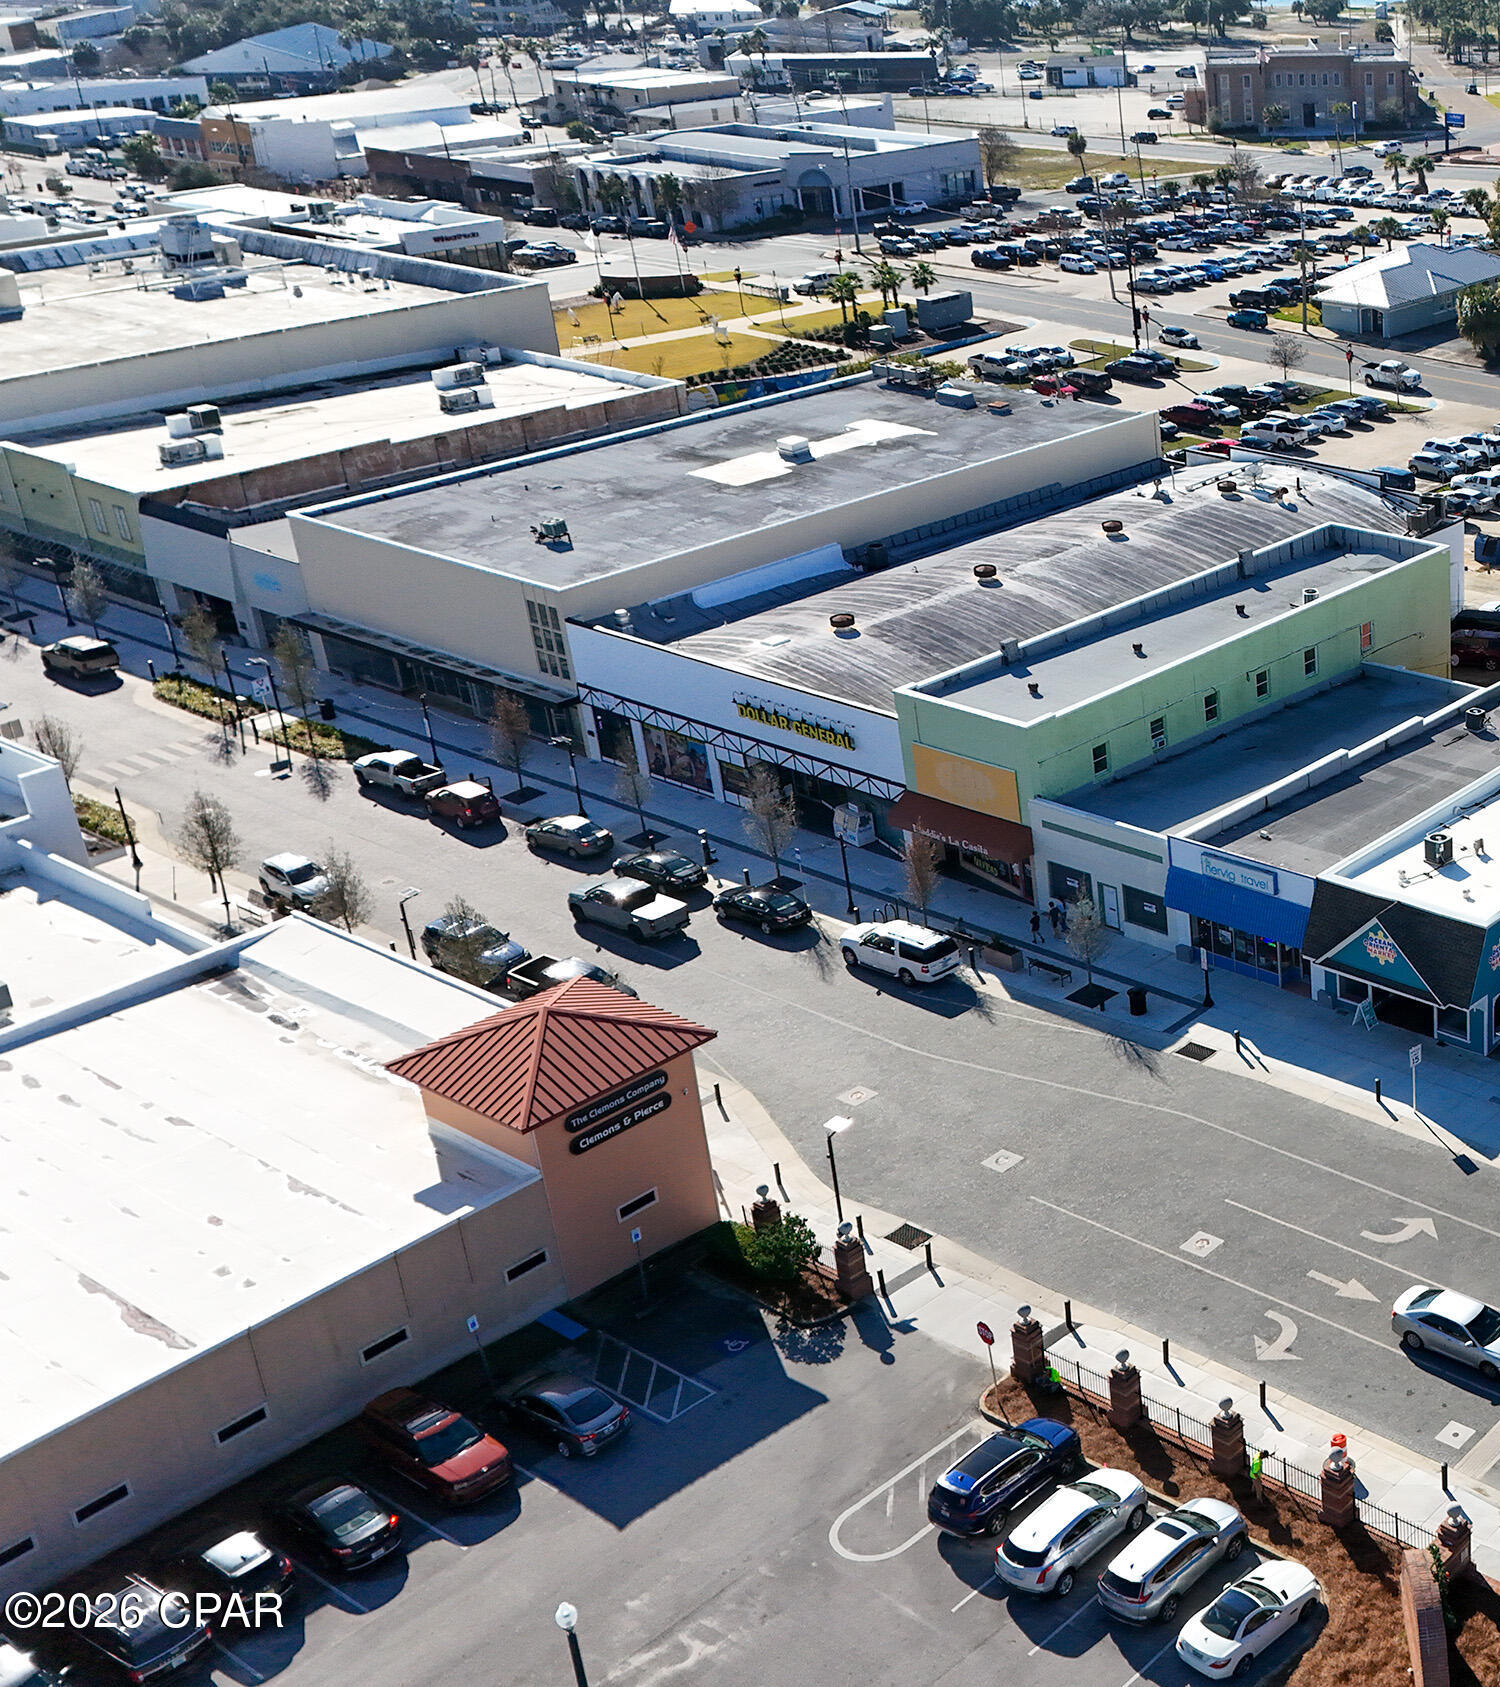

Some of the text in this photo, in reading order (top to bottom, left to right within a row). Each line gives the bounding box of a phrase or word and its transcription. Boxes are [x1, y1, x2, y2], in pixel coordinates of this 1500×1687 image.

[737, 703, 855, 751] DOLLAR GENERAL
[1205, 863, 1269, 890] hervig travel
[1363, 939, 1396, 954] ORIENTAL
[1368, 936, 1393, 948] OCEAN
[1367, 946, 1397, 960] MARKET
[1412, 1055, 1420, 1065] 15
[570, 1075, 666, 1127] The Clemons Company
[580, 1100, 665, 1149] Clemons & Pierce
